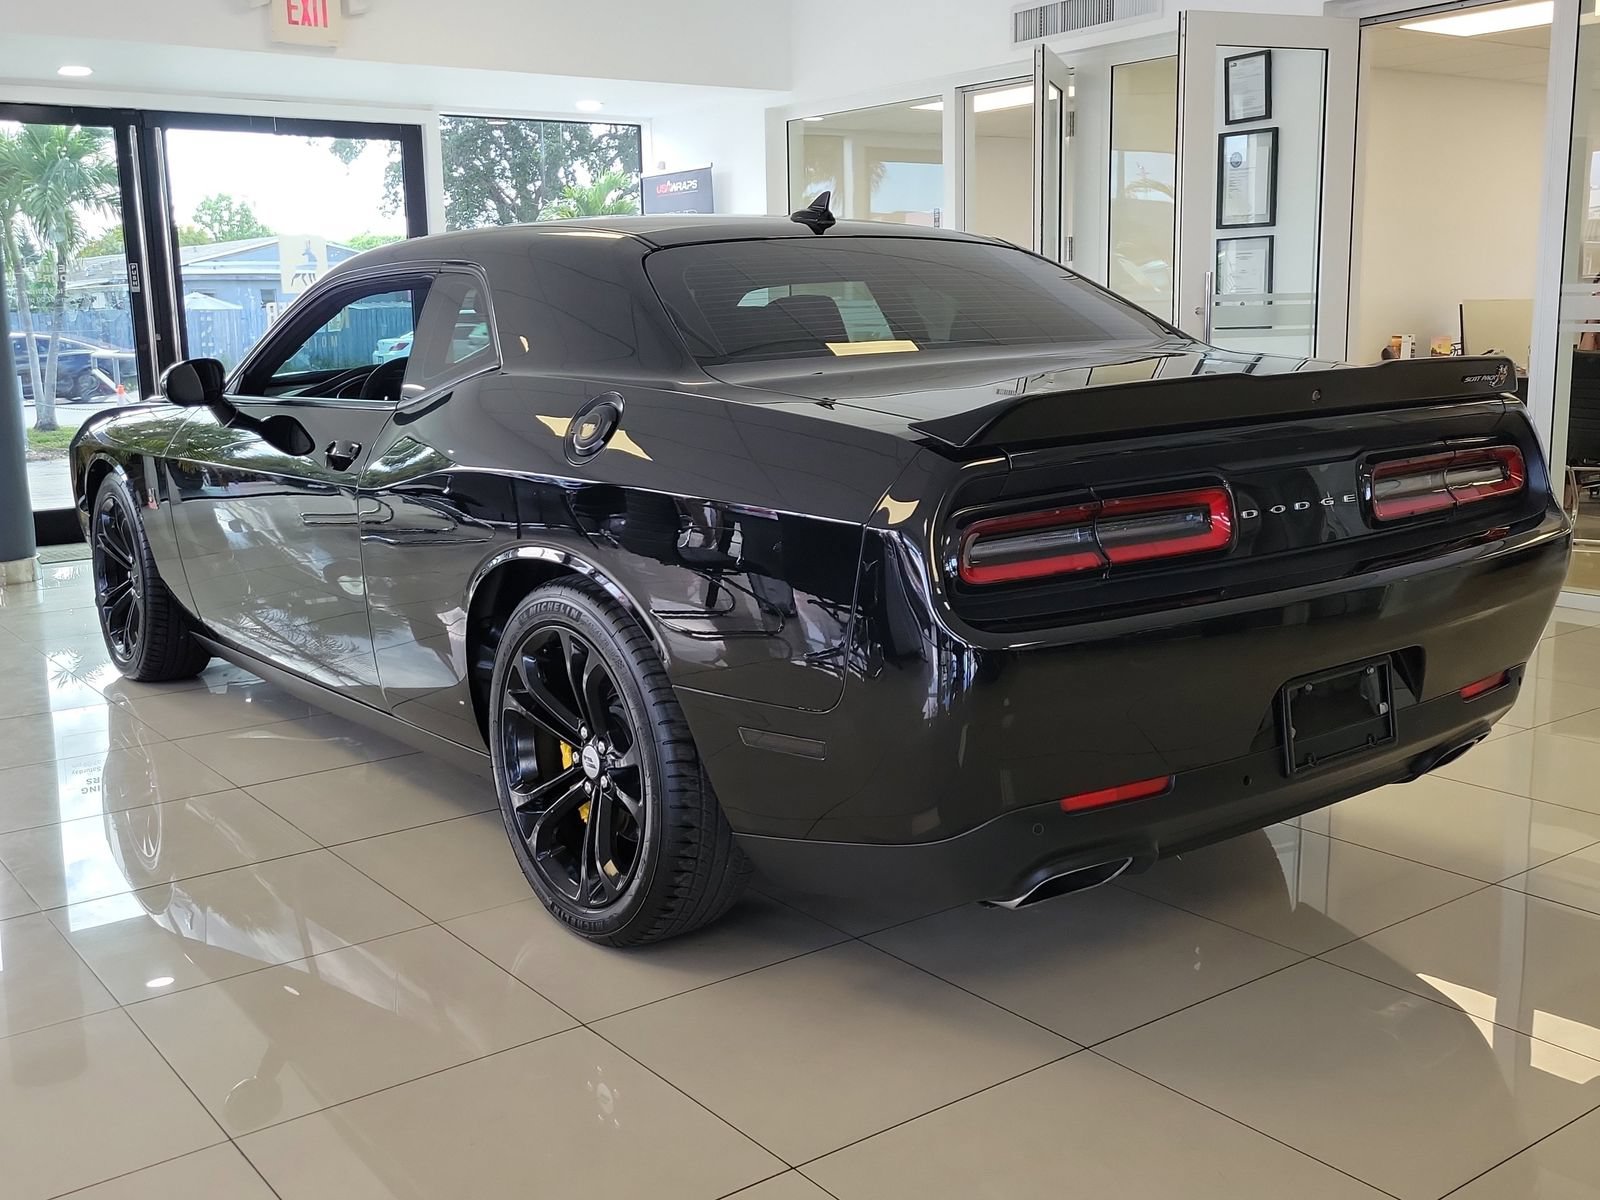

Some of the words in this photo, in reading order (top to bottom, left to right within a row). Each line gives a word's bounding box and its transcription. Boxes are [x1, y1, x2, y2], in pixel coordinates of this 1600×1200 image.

[286, 0, 328, 28] EXIT
[1241, 494, 1356, 519] DODGE
[529, 600, 580, 619] MICHELIN
